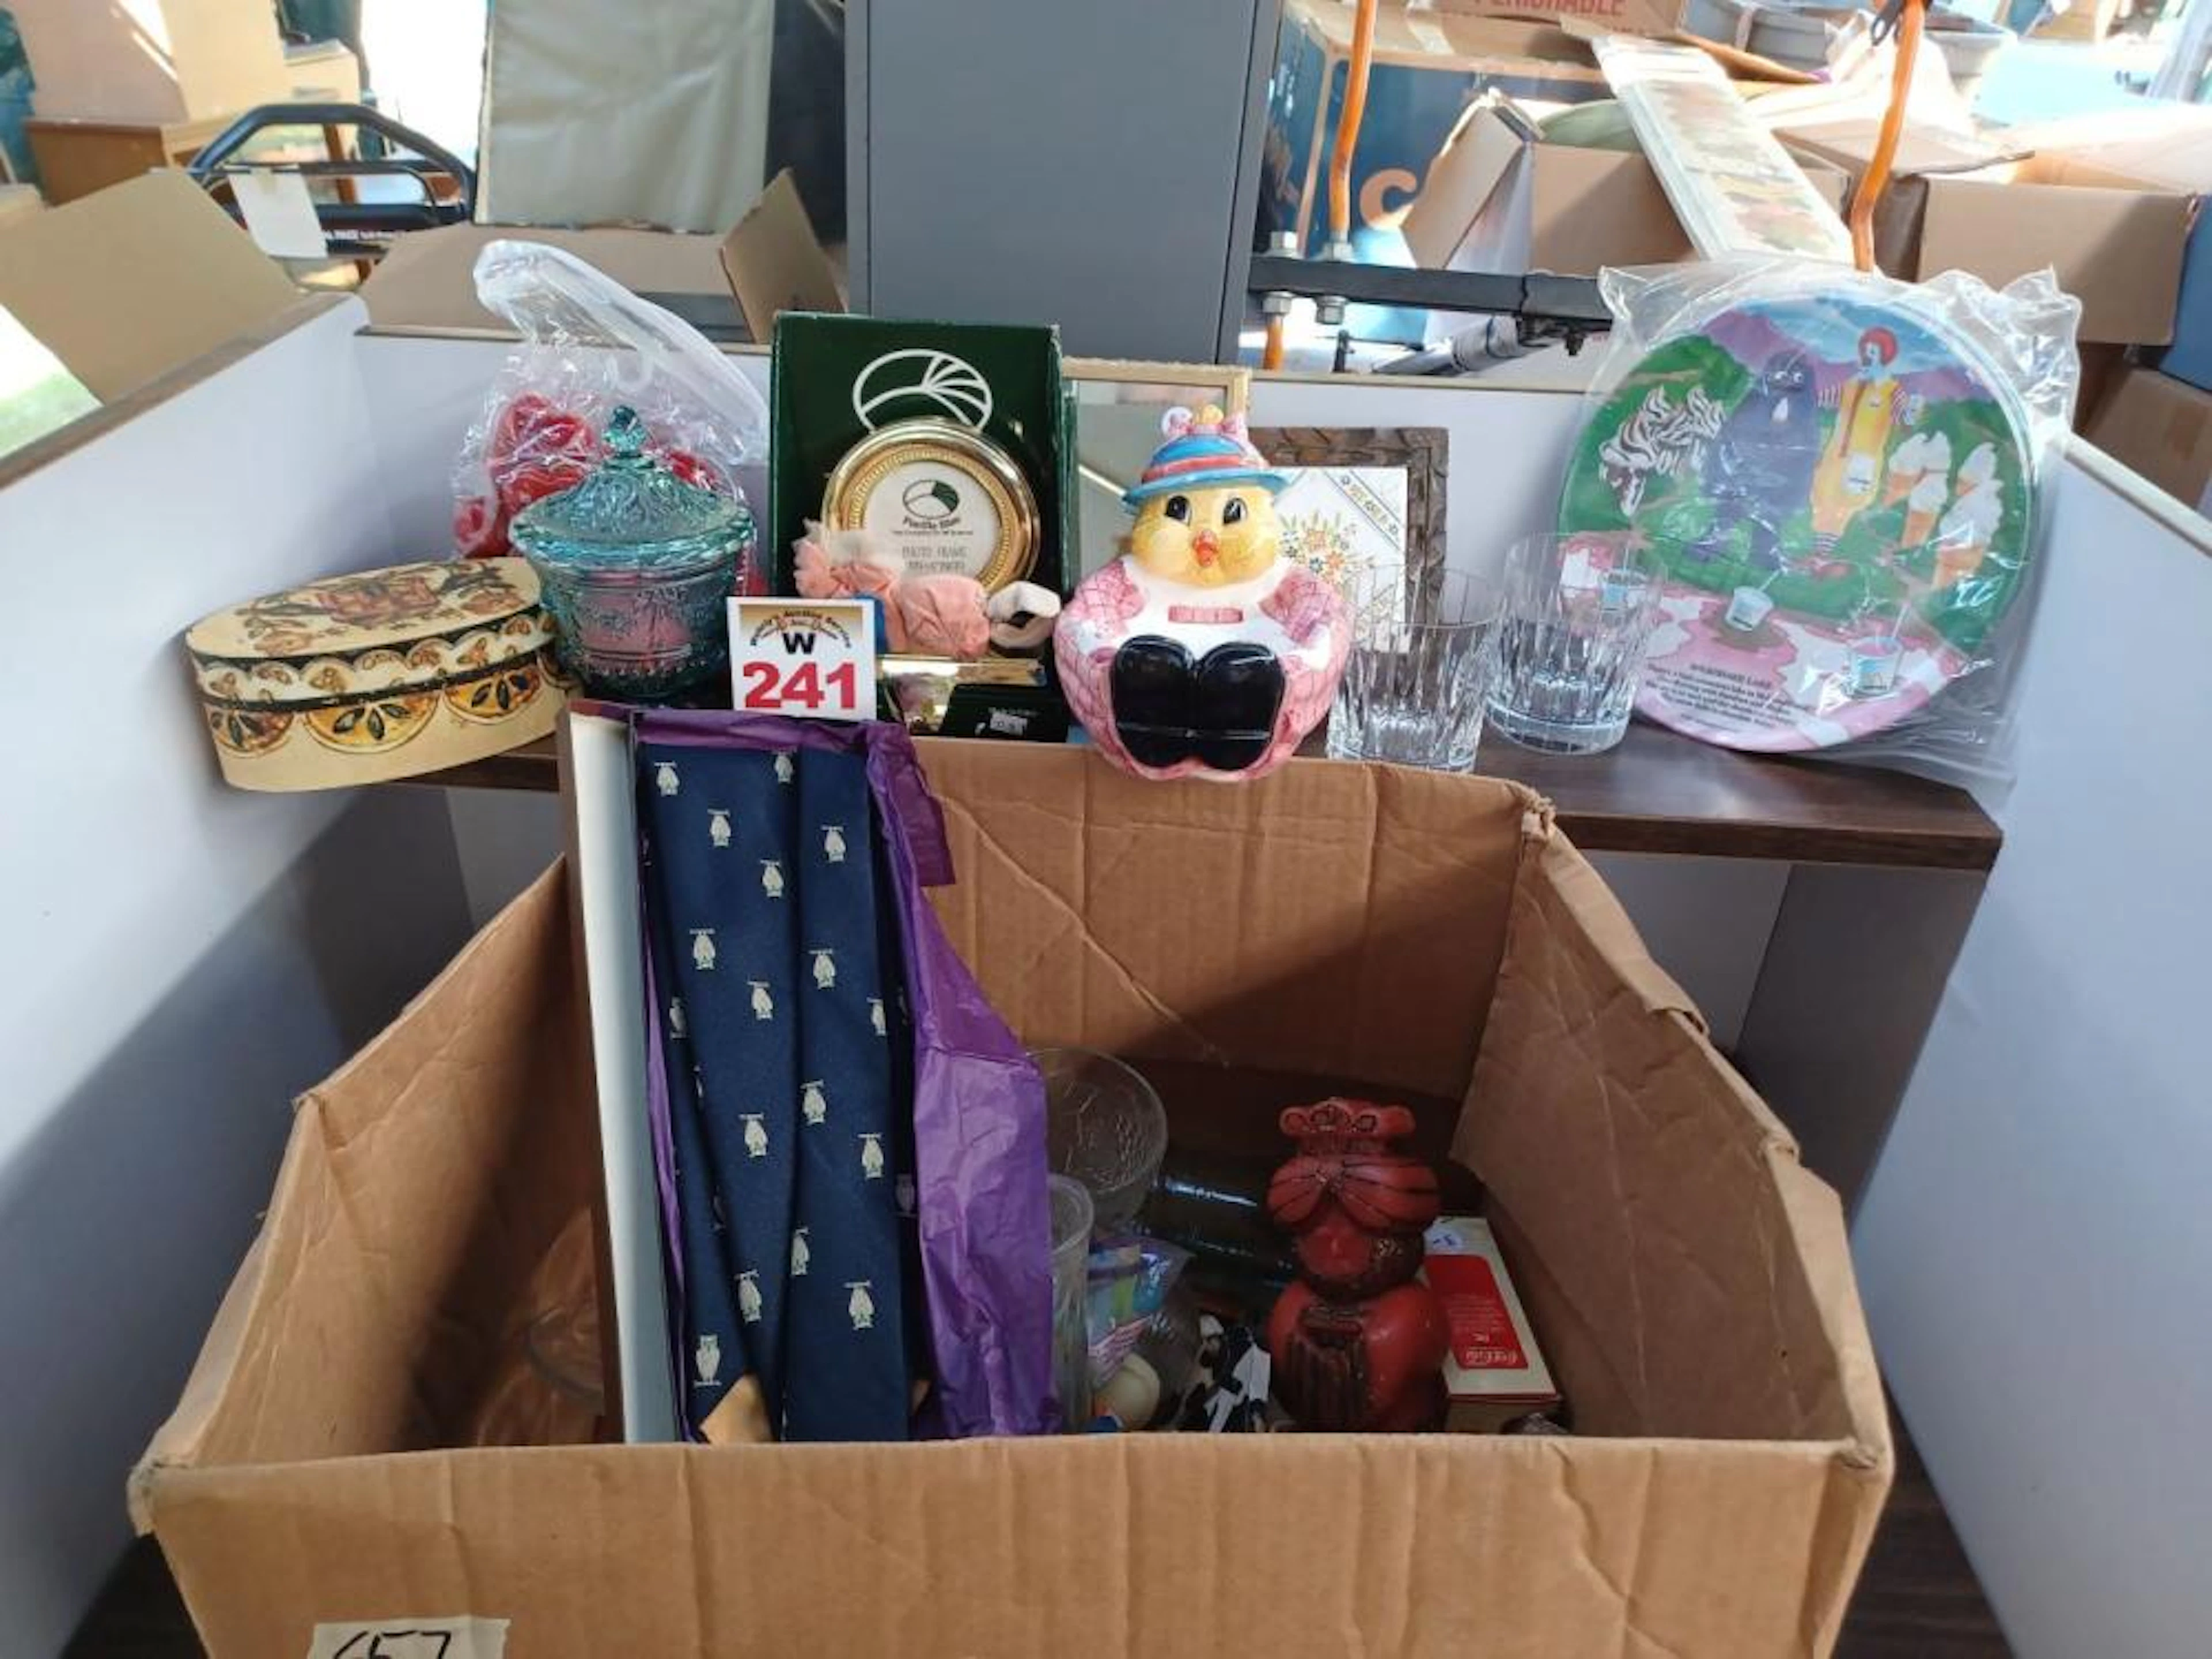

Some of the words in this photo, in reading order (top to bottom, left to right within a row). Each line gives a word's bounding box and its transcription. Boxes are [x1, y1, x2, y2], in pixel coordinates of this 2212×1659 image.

[1474, 0, 1623, 17] SHABLE
[782, 633, 816, 654] W
[743, 661, 855, 709] 241
